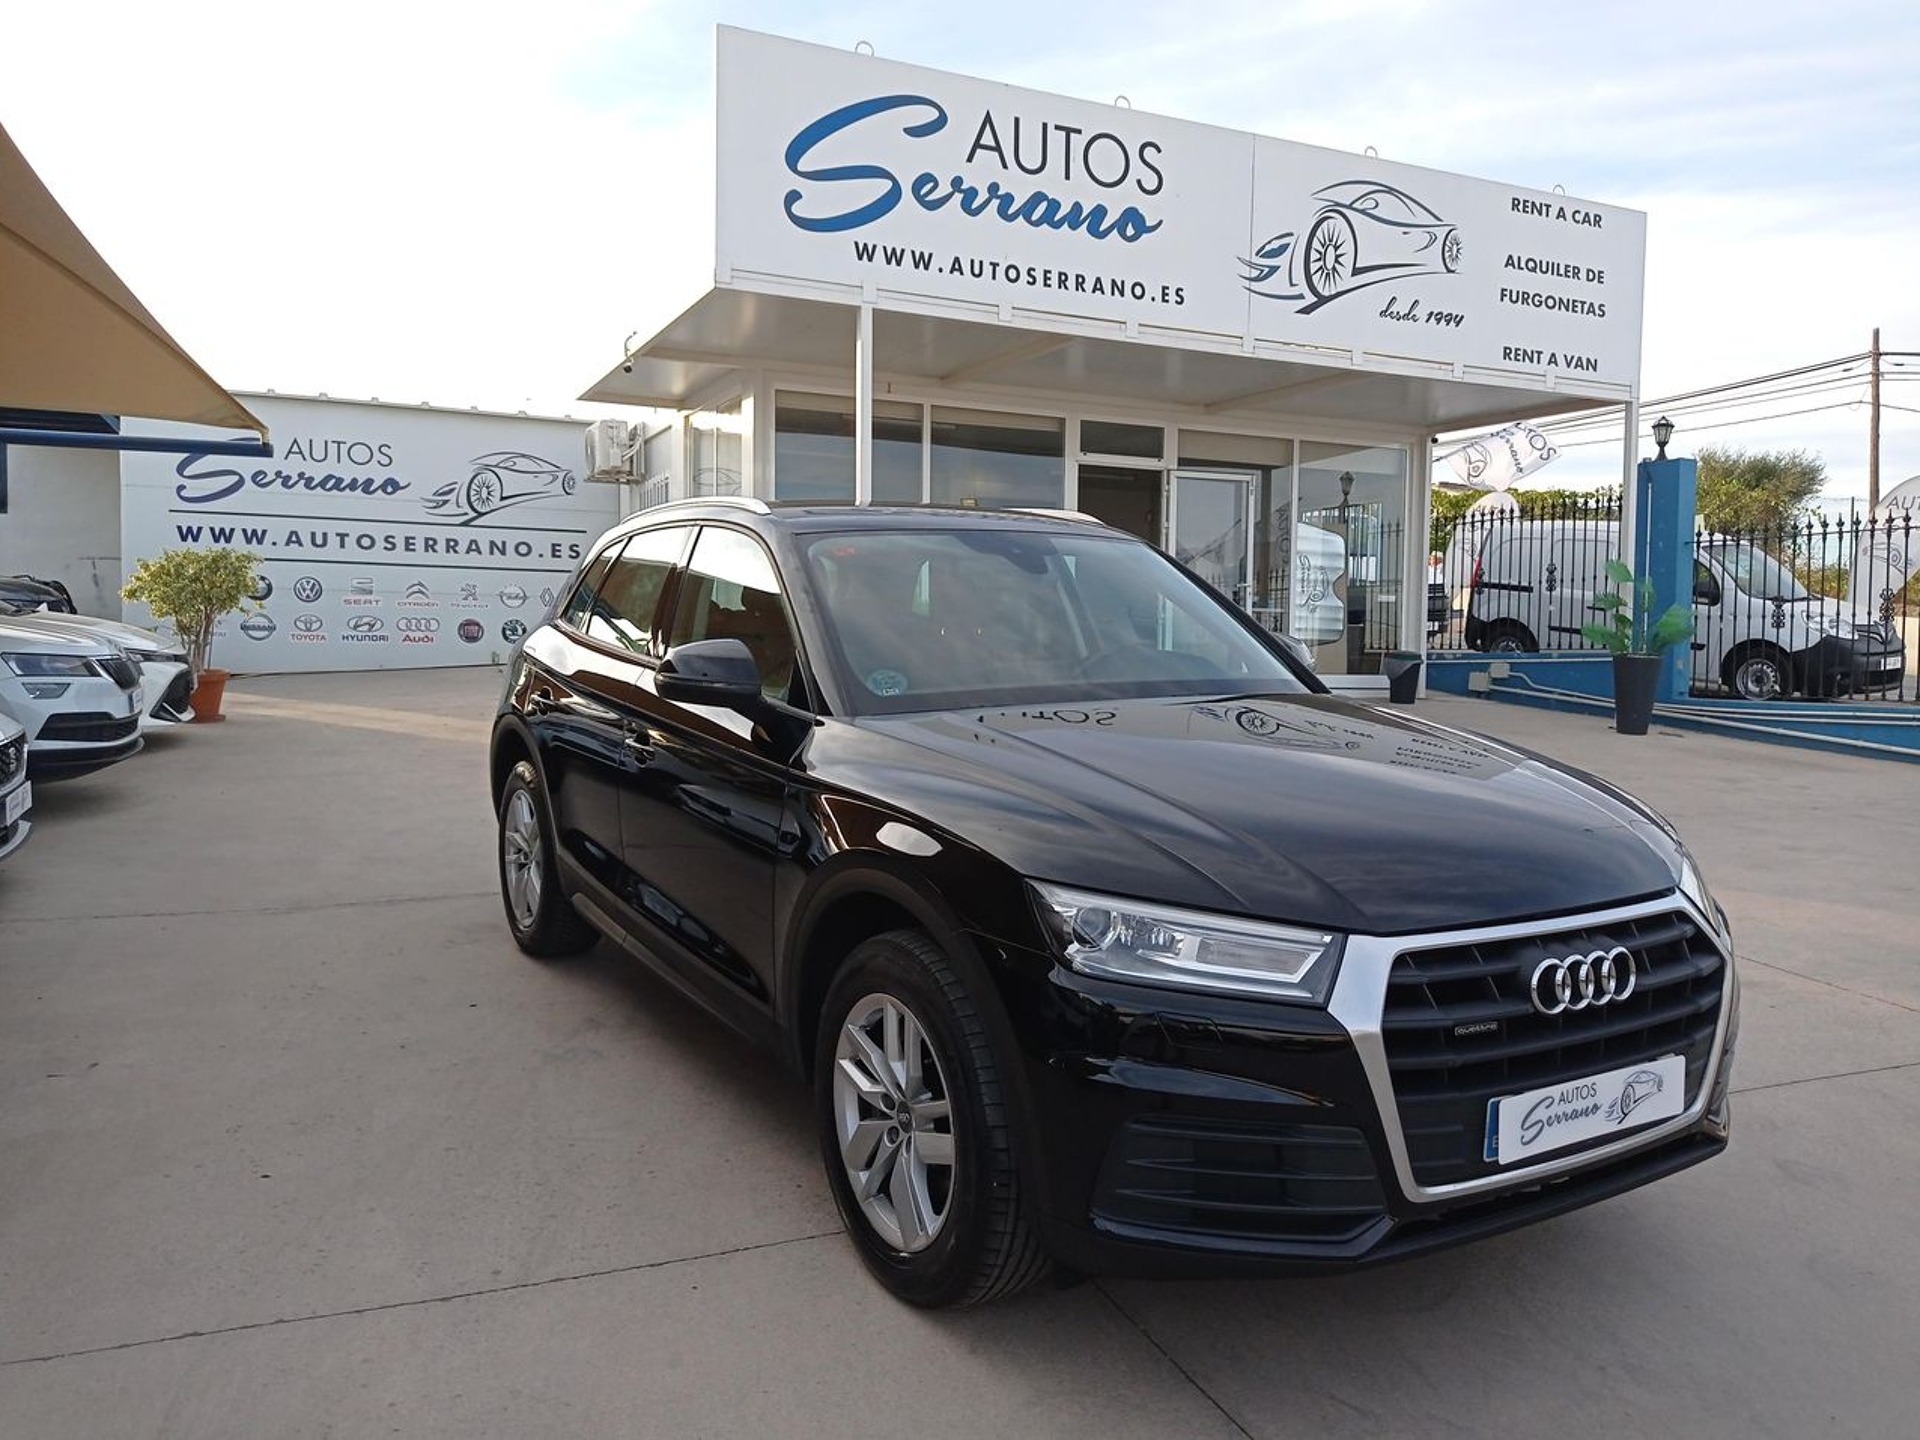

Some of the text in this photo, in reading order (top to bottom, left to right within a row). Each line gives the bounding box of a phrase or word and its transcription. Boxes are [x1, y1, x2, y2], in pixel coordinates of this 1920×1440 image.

[966, 109, 1164, 196] AUTOS
[784, 94, 1164, 243] Serrano
[1510, 197, 1603, 230] RENT A CAR
[854, 241, 1185, 306] WWW.AUTOSERRANO.ES
[1504, 254, 1606, 285] ALQUILER DE
[1379, 296, 1465, 328] desde 1994
[1500, 288, 1607, 319] FURGONETAS
[1502, 345, 1599, 373] RENT A VAN
[284, 438, 394, 467] AUTOS
[176, 437, 411, 504] Serrano
[177, 525, 582, 560] WWW.AUTOSERRANO.ES
[291, 634, 327, 642] TOYOTA
[341, 634, 389, 642] HYUNDAI
[402, 634, 434, 644] Audi
[1557, 1082, 1598, 1106] AUTOS
[1520, 1095, 1604, 1146] Serrano
